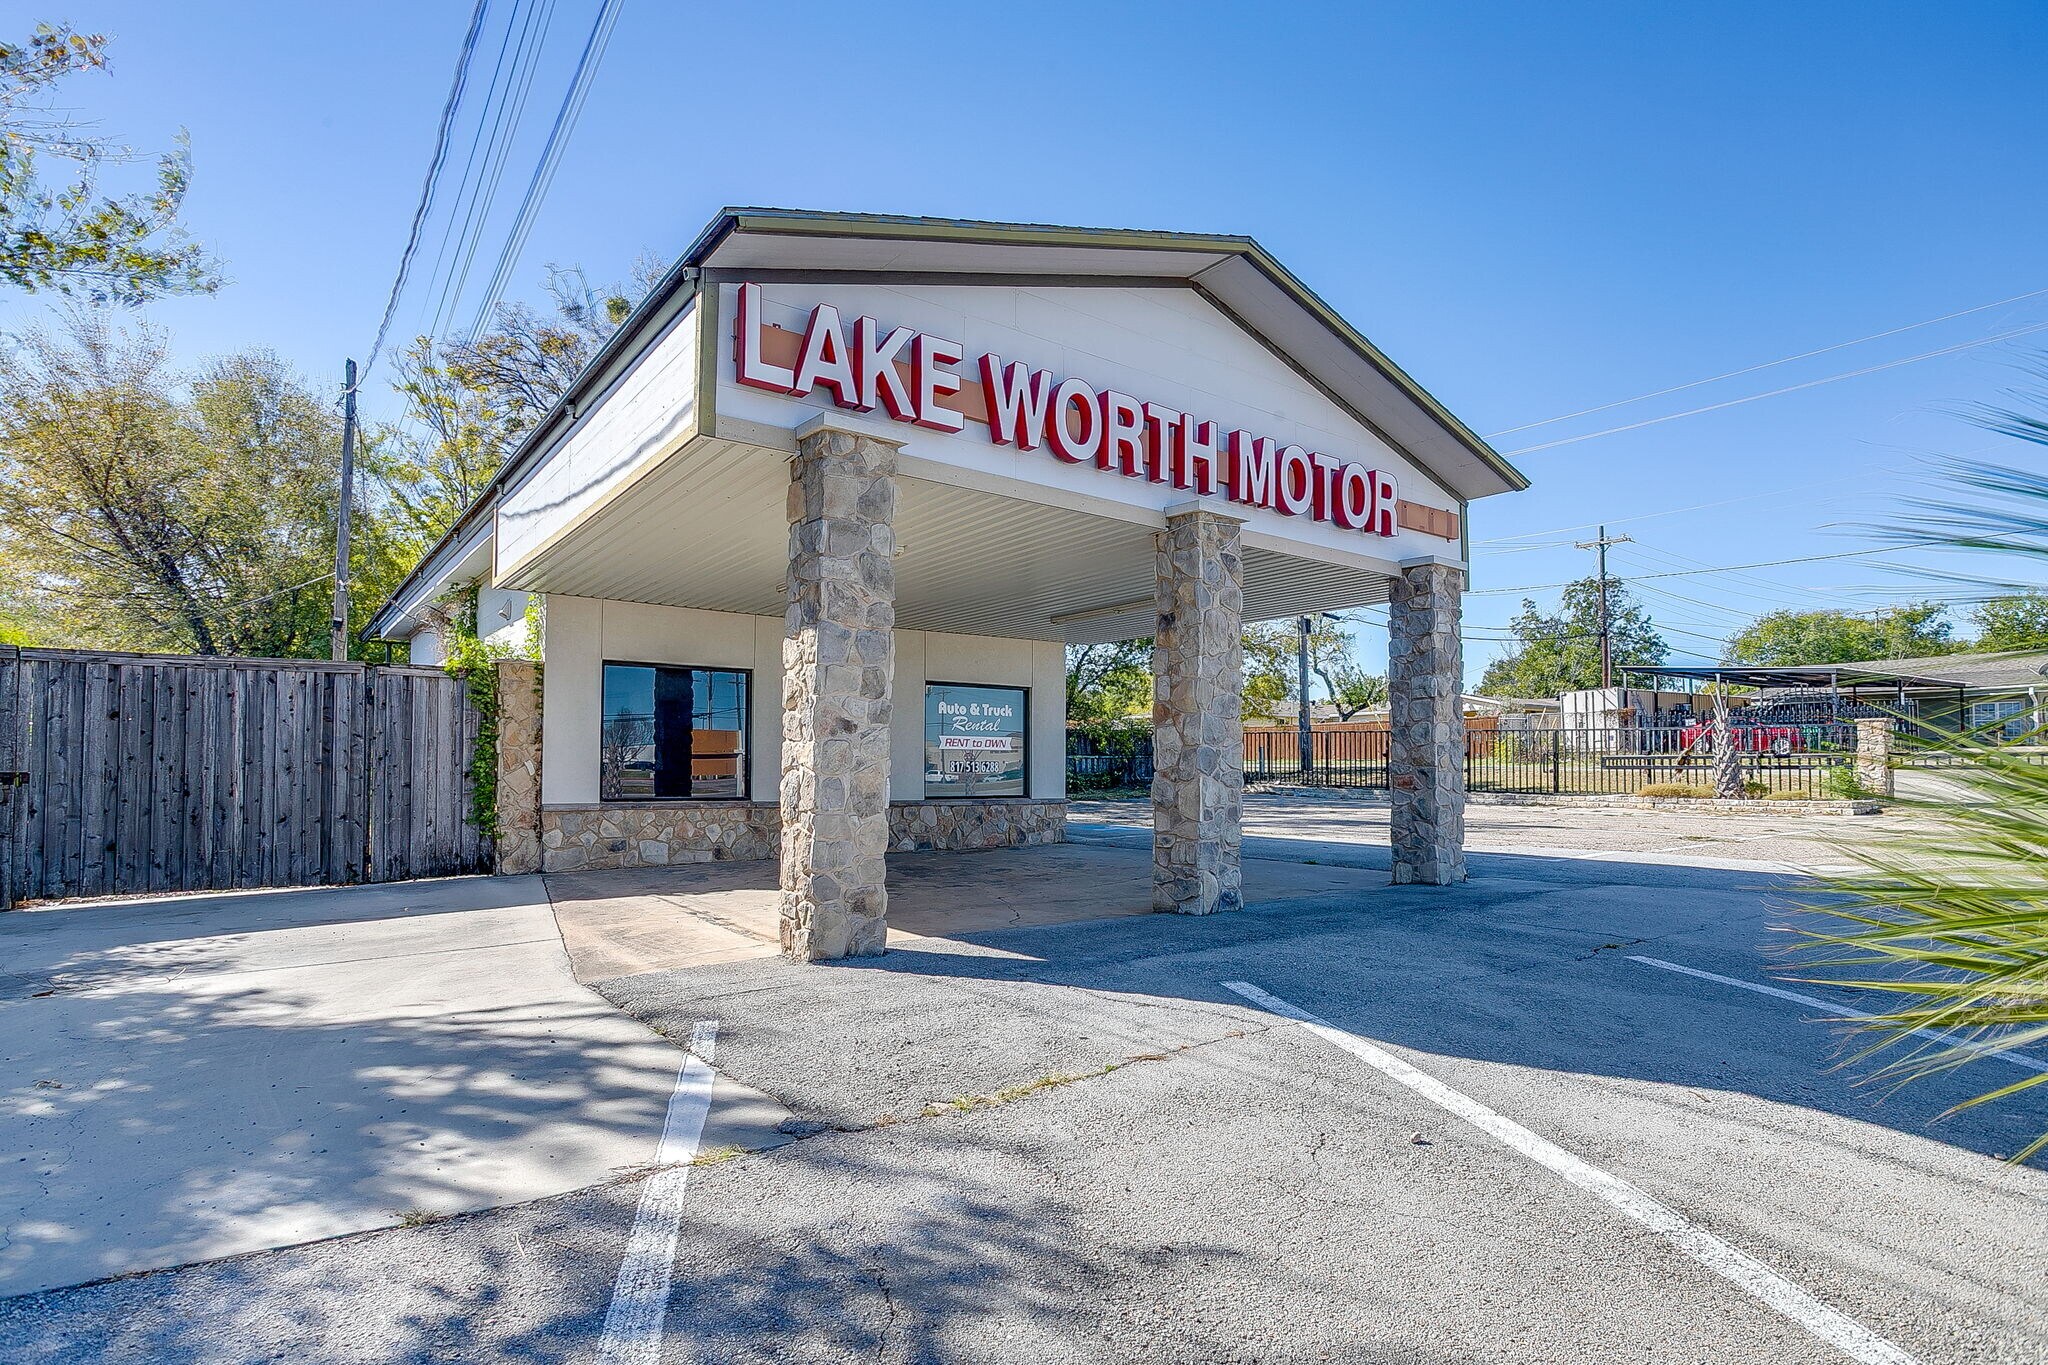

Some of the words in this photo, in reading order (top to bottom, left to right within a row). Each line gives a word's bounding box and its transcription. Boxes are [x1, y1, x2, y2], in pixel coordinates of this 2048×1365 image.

[736, 281, 965, 434] LAKE
[978, 352, 1218, 496] WORTH
[1228, 429, 1400, 538] MOTOR
[938, 701, 967, 715] Auto
[970, 703, 980, 716] &
[982, 703, 1013, 717] Truck
[951, 715, 1001, 732] Rental
[944, 738, 970, 748] RENT
[972, 739, 982, 748] to
[984, 739, 1007, 749] OWN
